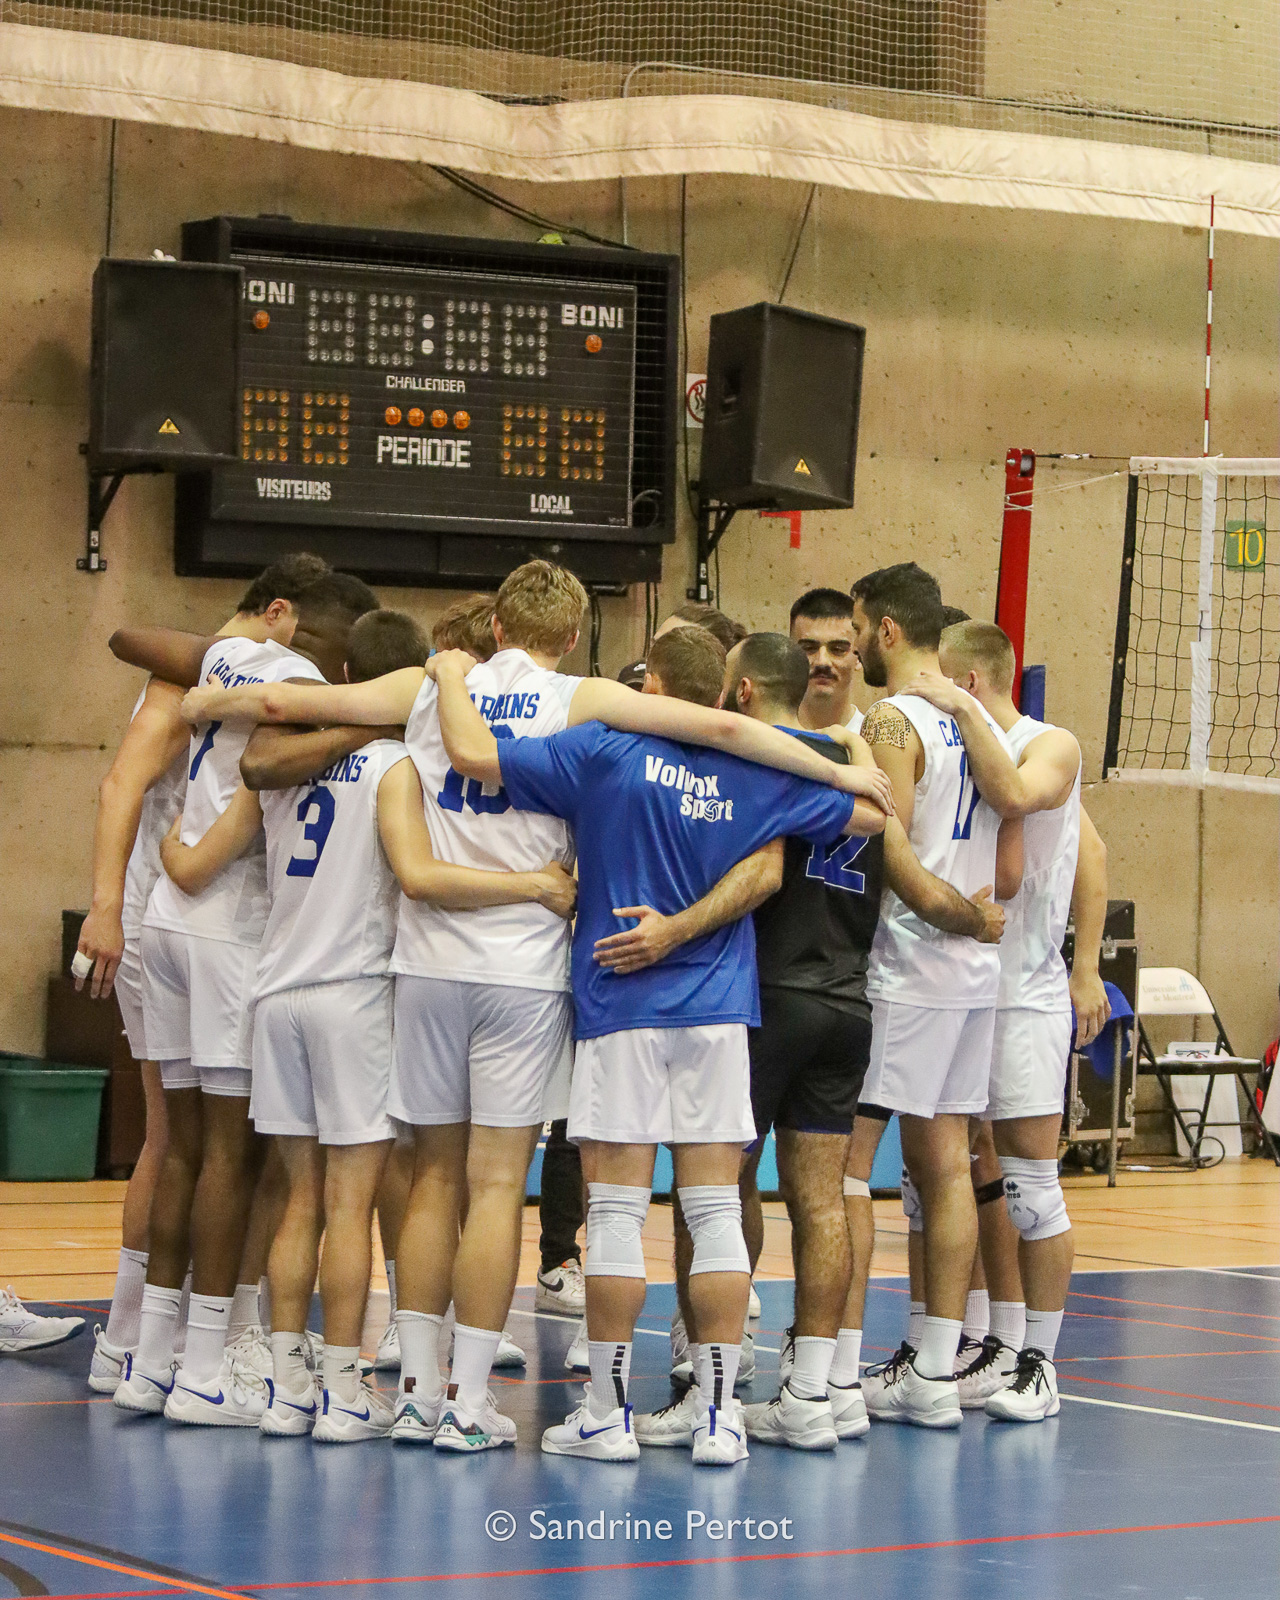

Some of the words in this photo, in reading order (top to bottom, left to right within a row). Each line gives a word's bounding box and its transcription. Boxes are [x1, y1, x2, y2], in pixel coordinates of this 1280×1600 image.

[242, 280, 295, 304] ONI
[561, 304, 624, 329] BONI
[386, 375, 466, 393] CHALLENGER
[377, 435, 471, 468] PERIODE
[257, 477, 332, 501] VISITEURS
[530, 494, 574, 515] LOCAL
[1230, 527, 1264, 565] 10
[645, 754, 720, 798] Volvox
[680, 793, 734, 822] Sport
[286, 785, 336, 878] 3
